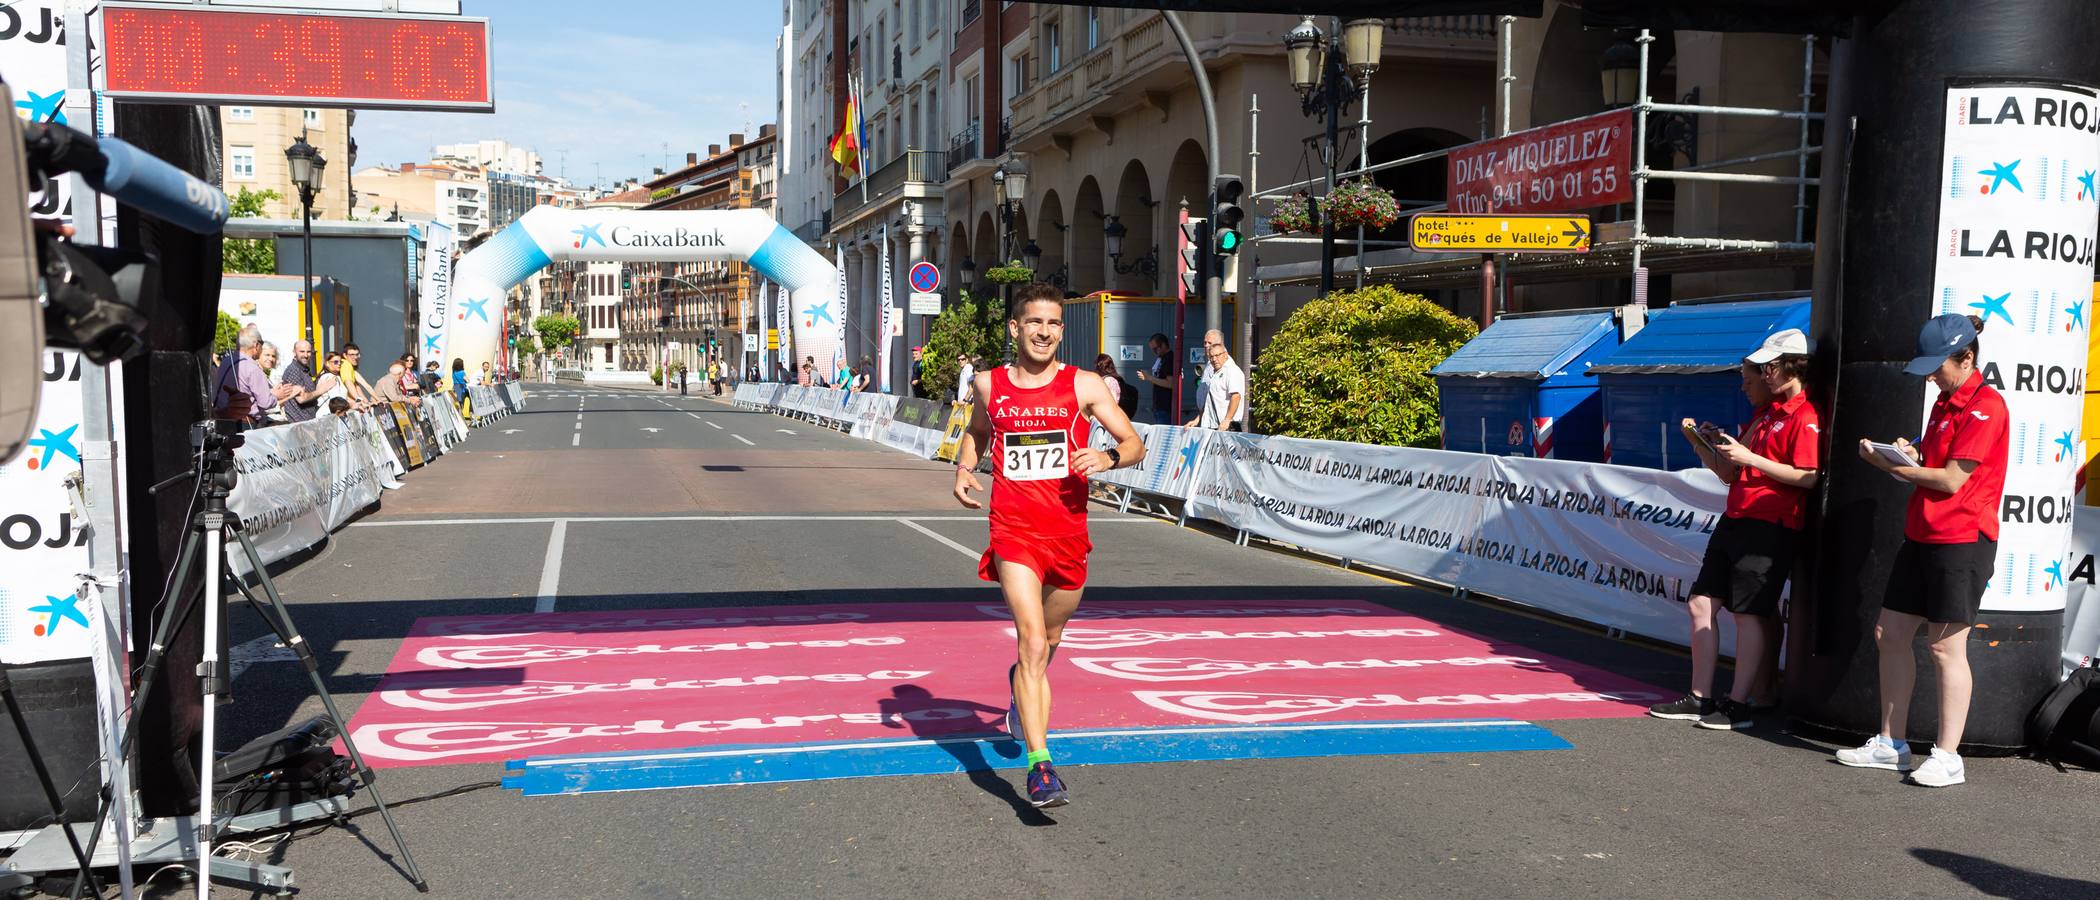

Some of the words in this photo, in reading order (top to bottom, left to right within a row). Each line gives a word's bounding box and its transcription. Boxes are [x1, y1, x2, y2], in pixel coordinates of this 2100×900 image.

[1969, 96, 2025, 125] LA
[1493, 181, 1522, 209] 941
[1531, 177, 1555, 203] 50
[1563, 171, 1582, 199] 01
[1592, 166, 1617, 195] 55
[611, 226, 725, 247] CaixaBank
[1418, 232, 1476, 244] Mrqués
[1486, 232, 1501, 243] de
[1512, 232, 1558, 245] Vallejo
[1960, 229, 2015, 258] LA
[2024, 231, 2093, 267] RIOJA
[428, 246, 447, 330] CaixaBank
[2015, 363, 2082, 396] RIOJA
[995, 406, 1068, 418] AÑARES
[1014, 419, 1046, 427] RIOJA
[1008, 448, 1065, 471] 3172
[1282, 453, 1312, 472] RIOJA
[1330, 462, 1362, 480] RIOJA
[1381, 469, 1412, 487] RIOJA
[1434, 474, 1471, 494] RIOJA
[1493, 480, 1535, 504] RIOJA
[1561, 491, 1605, 515] RIOJA
[1633, 504, 1695, 530] RIOJA
[2002, 494, 2072, 524] RIOJA
[1266, 498, 1296, 517] RIOJA
[1315, 508, 1345, 528] RIOJA
[1362, 518, 1396, 538] RIOJA
[1417, 527, 1452, 550] RIOJA
[1475, 538, 1515, 564] RIOJA
[1541, 553, 1588, 580] RIOJA
[1619, 567, 1667, 599] RIOJA
[451, 636, 905, 659] Cadarso
[1180, 692, 1664, 711] Cadarso
[395, 708, 976, 745] Cadarso
